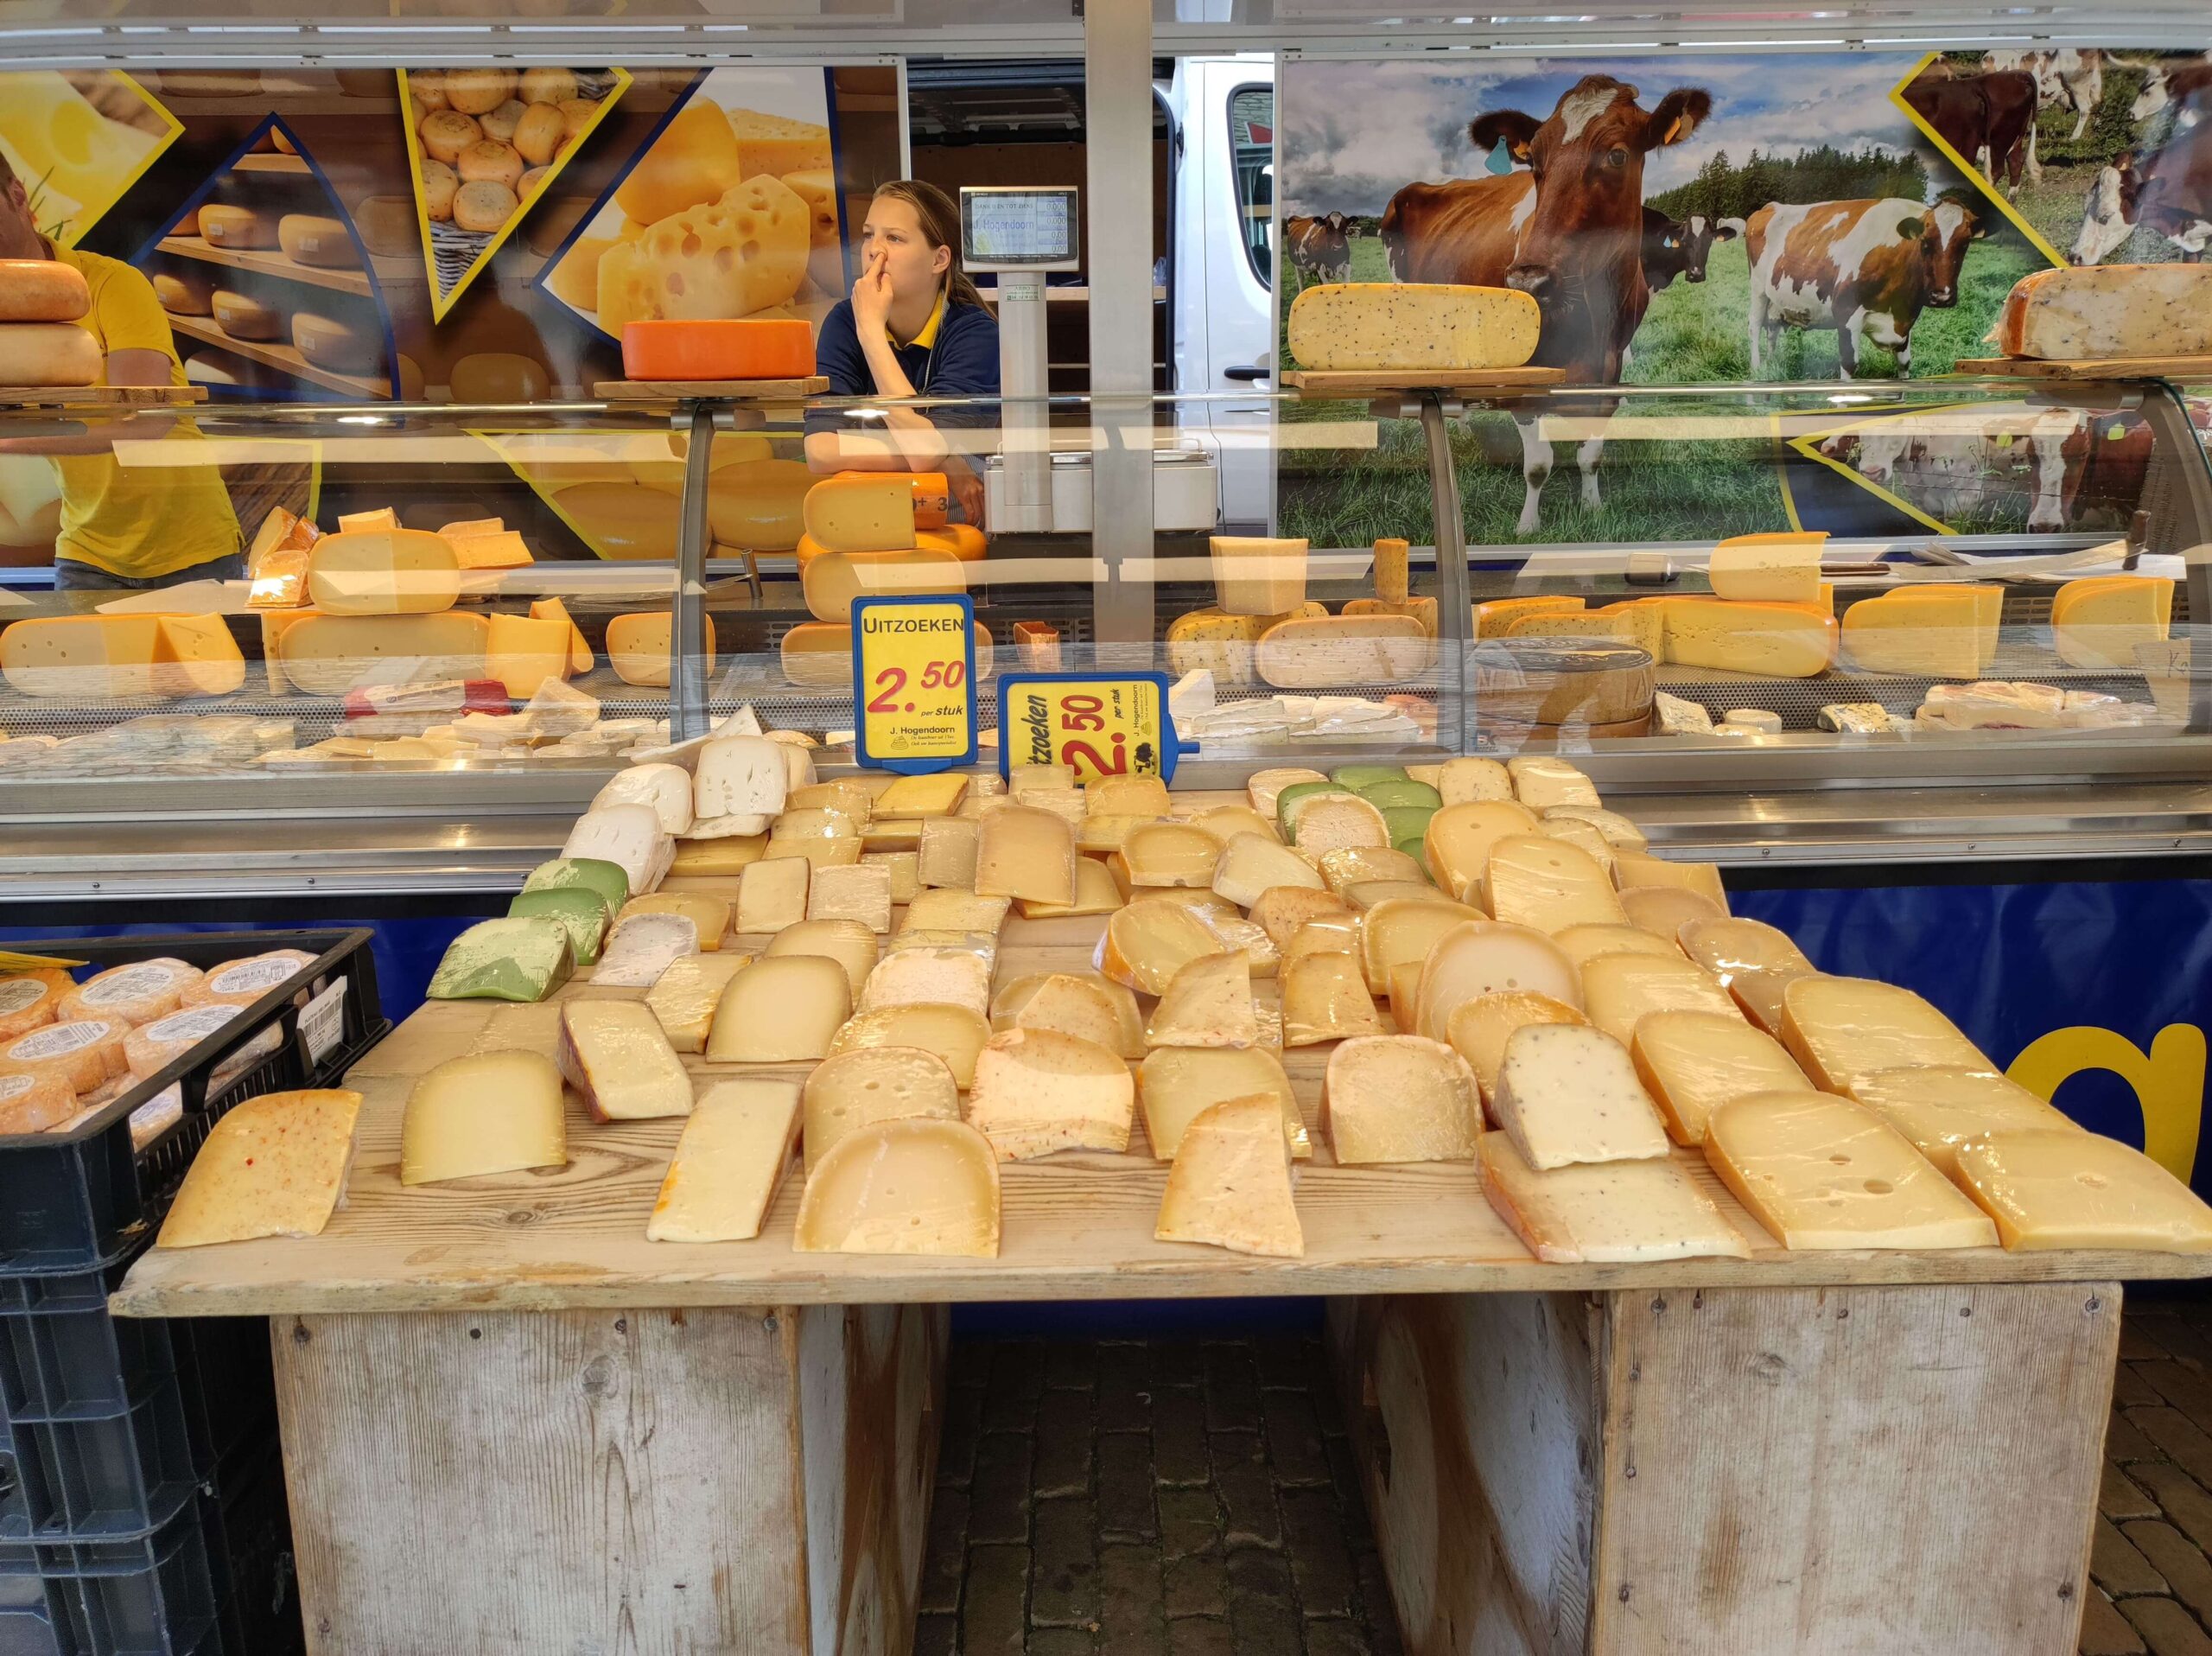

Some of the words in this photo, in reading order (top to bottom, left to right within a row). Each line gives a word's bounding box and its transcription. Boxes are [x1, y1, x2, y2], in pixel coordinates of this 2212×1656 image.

[983, 219, 1034, 232] Hogendoorn
[864, 617, 964, 634] UITZOEKEN
[1109, 689, 1121, 704] stuk
[935, 705, 963, 717] stuk
[1114, 707, 1124, 719] per
[1132, 684, 1141, 729] Hogendoorn
[900, 726, 955, 736] Hogendoorn
[1020, 694, 1052, 765] tzoeken
